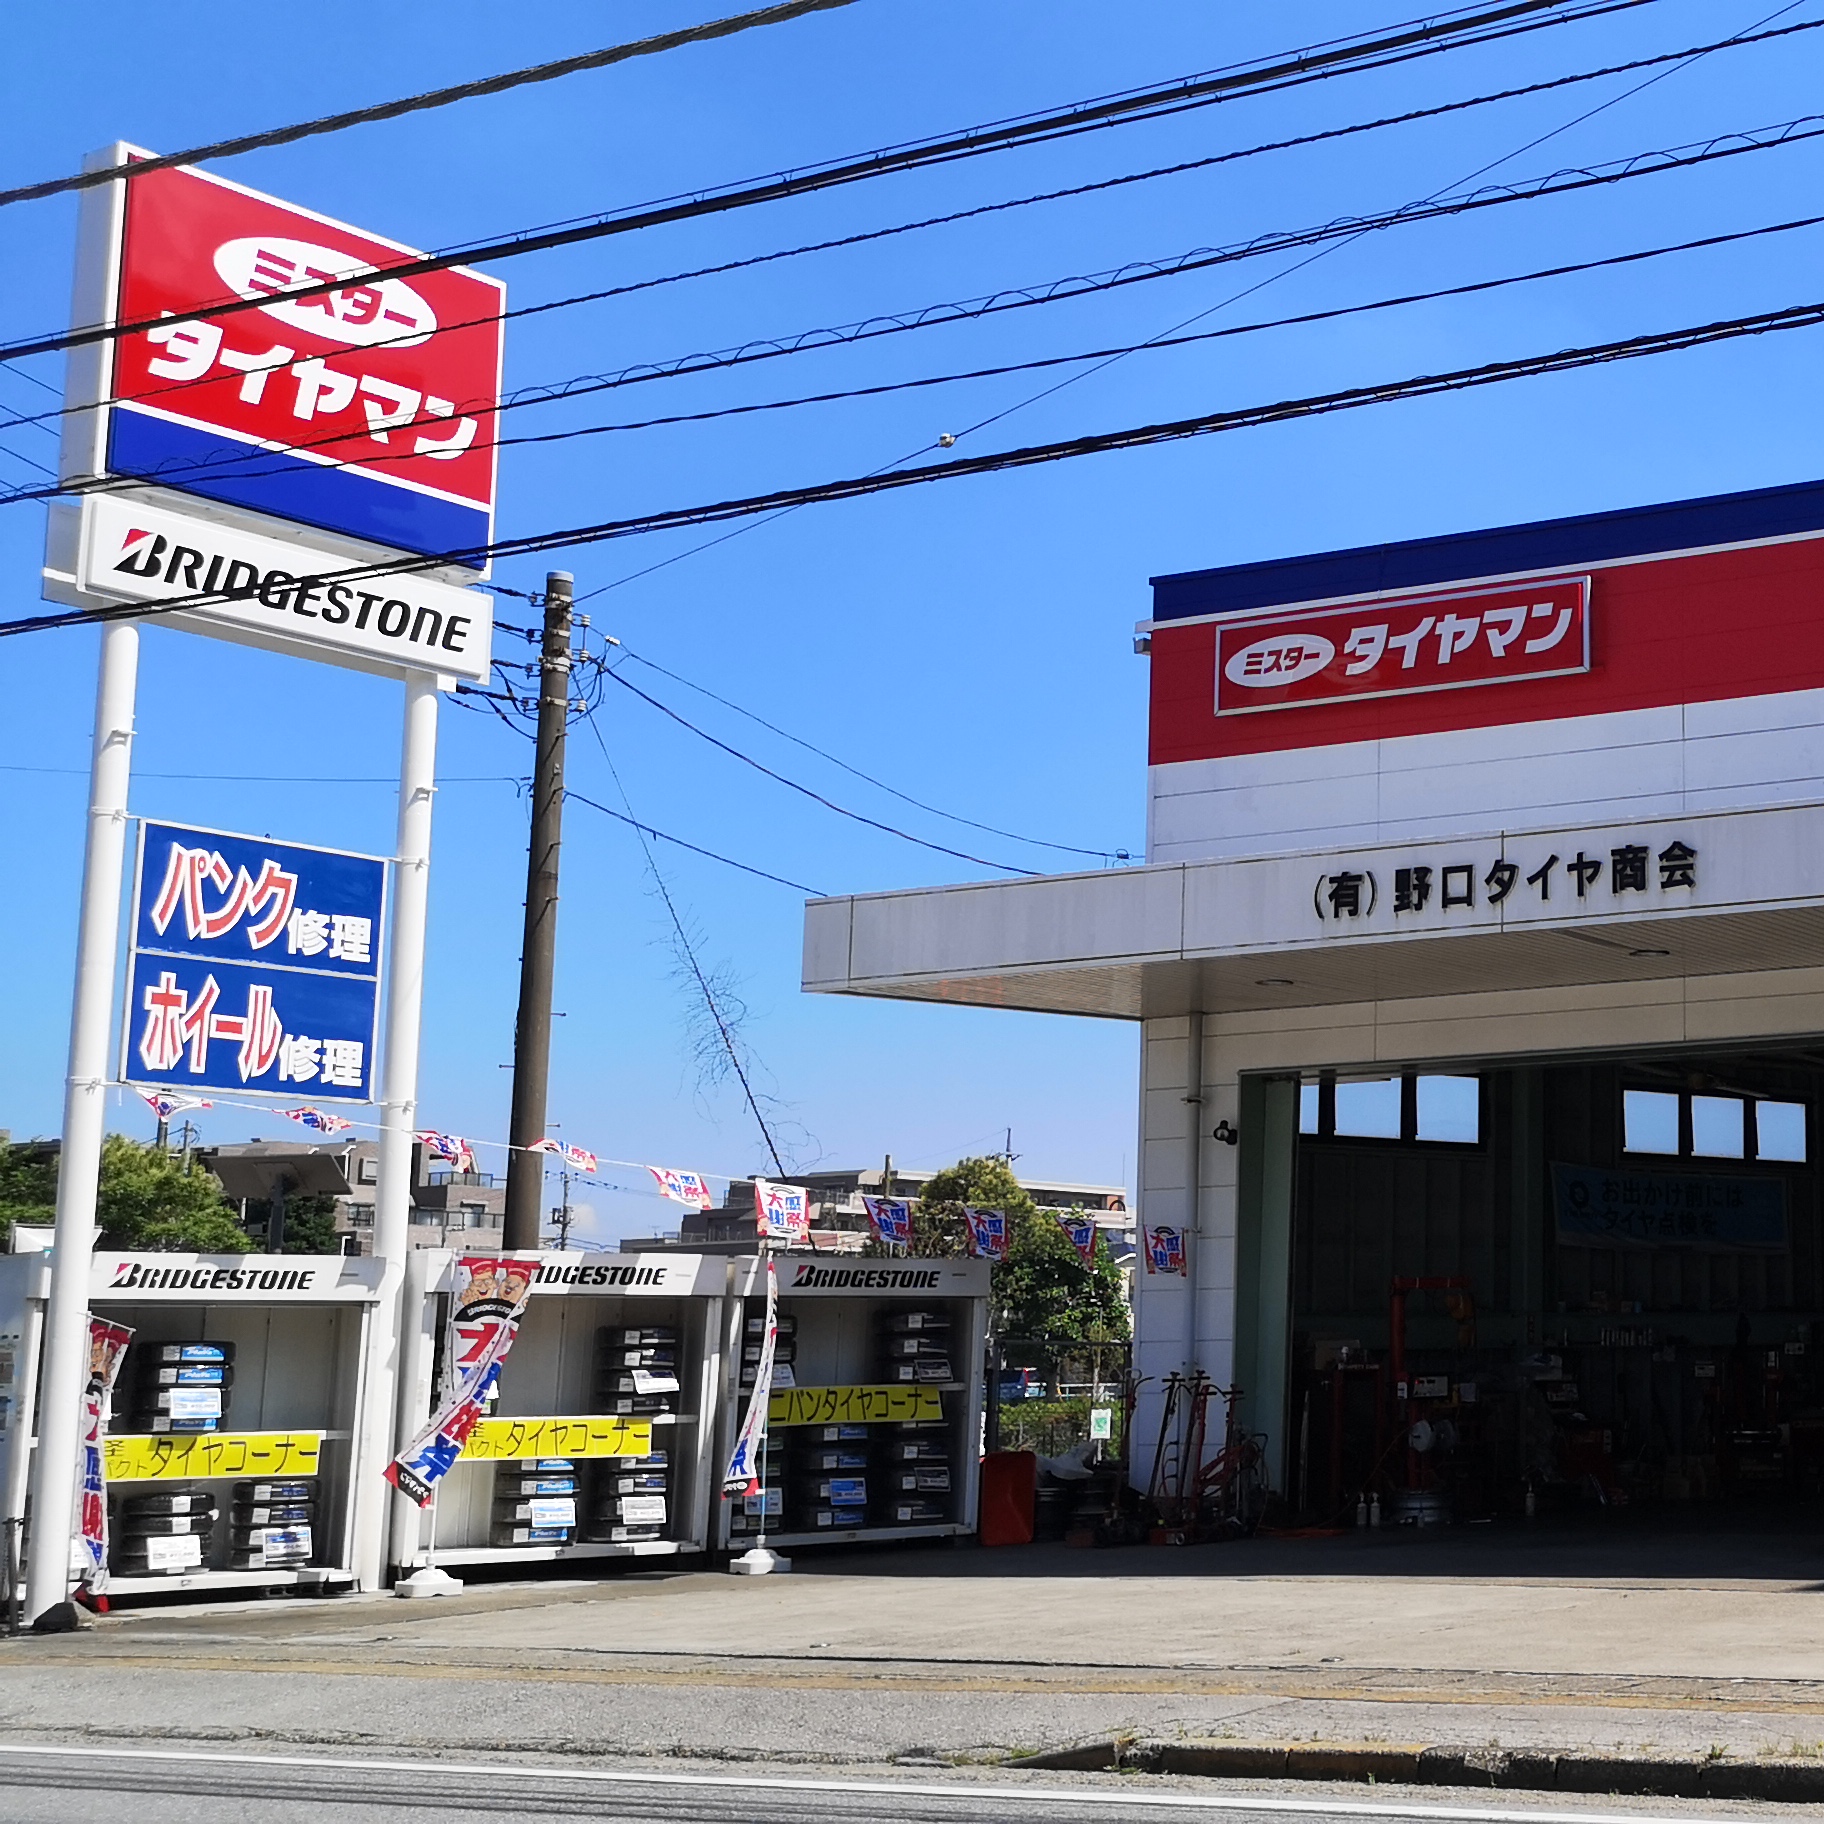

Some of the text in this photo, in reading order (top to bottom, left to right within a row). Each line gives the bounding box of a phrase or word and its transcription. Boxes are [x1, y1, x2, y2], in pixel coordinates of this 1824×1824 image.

[249, 248, 417, 326] ミスター
[148, 310, 479, 461] タイヤマン
[113, 528, 472, 654] BRIDGESTONE
[1243, 602, 1573, 676] ミスター タイヤマン
[151, 841, 372, 963] パンク修理
[140, 971, 364, 1088] ホイール修理
[108, 1263, 316, 1290] BRIDGESTONE
[535, 1265, 667, 1286] IDGESTONE
[791, 1265, 941, 1288] BRIDGESTONE
[770, 1386, 939, 1422] ニバンタイヤコーナー
[151, 1435, 318, 1477] タイヤコーナー
[506, 1419, 650, 1457] タイヤコーナー
